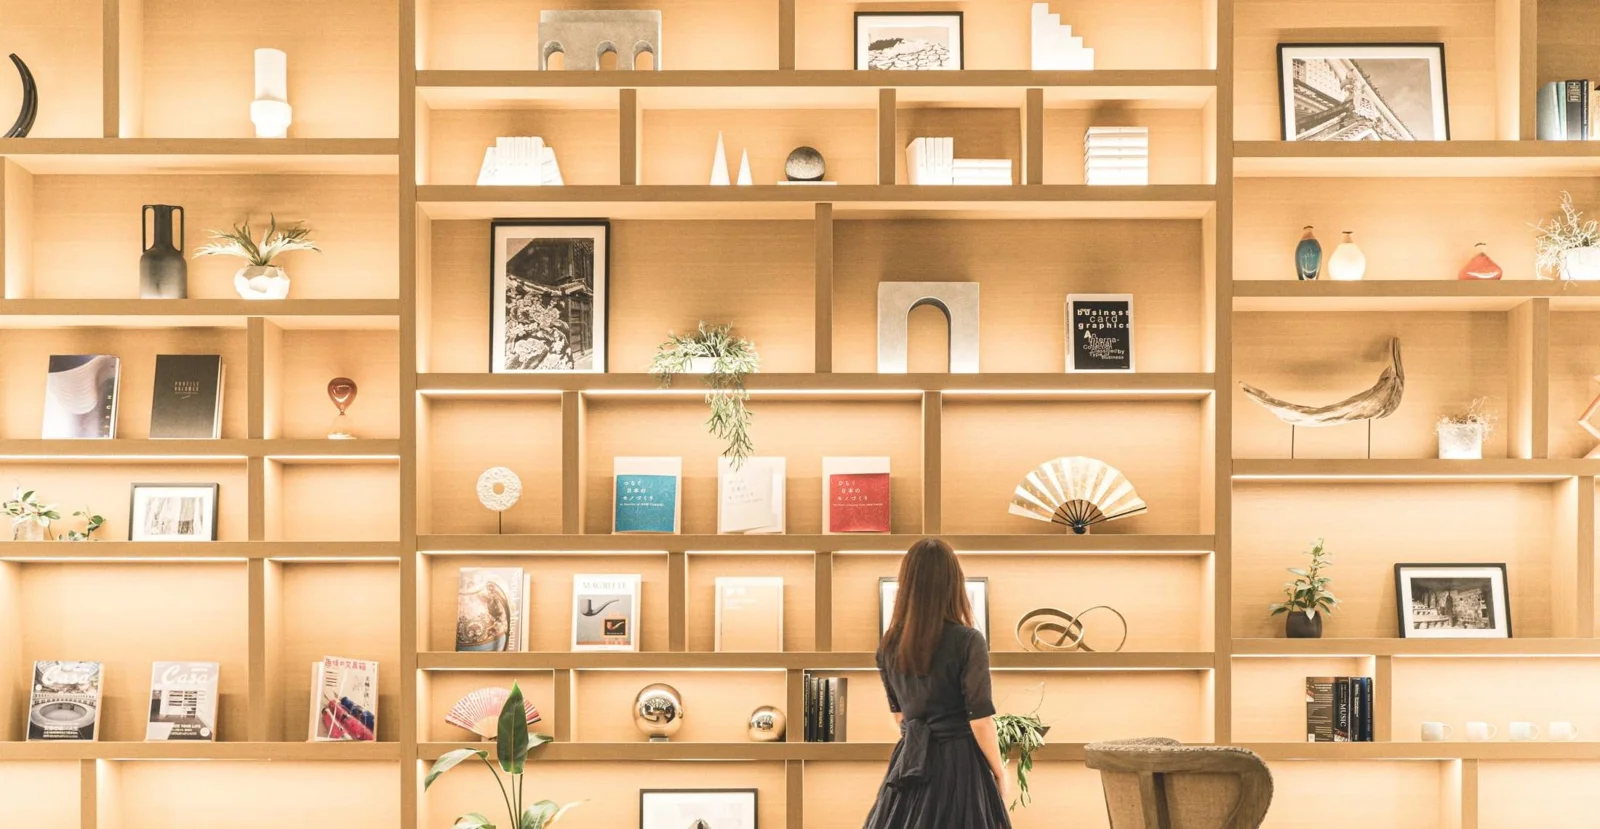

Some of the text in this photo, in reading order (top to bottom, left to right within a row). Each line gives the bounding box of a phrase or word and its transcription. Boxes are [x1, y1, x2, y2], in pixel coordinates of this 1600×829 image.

[1090, 315, 1117, 323] card
[1084, 330, 1097, 338] An
[161, 664, 208, 685] Casa
